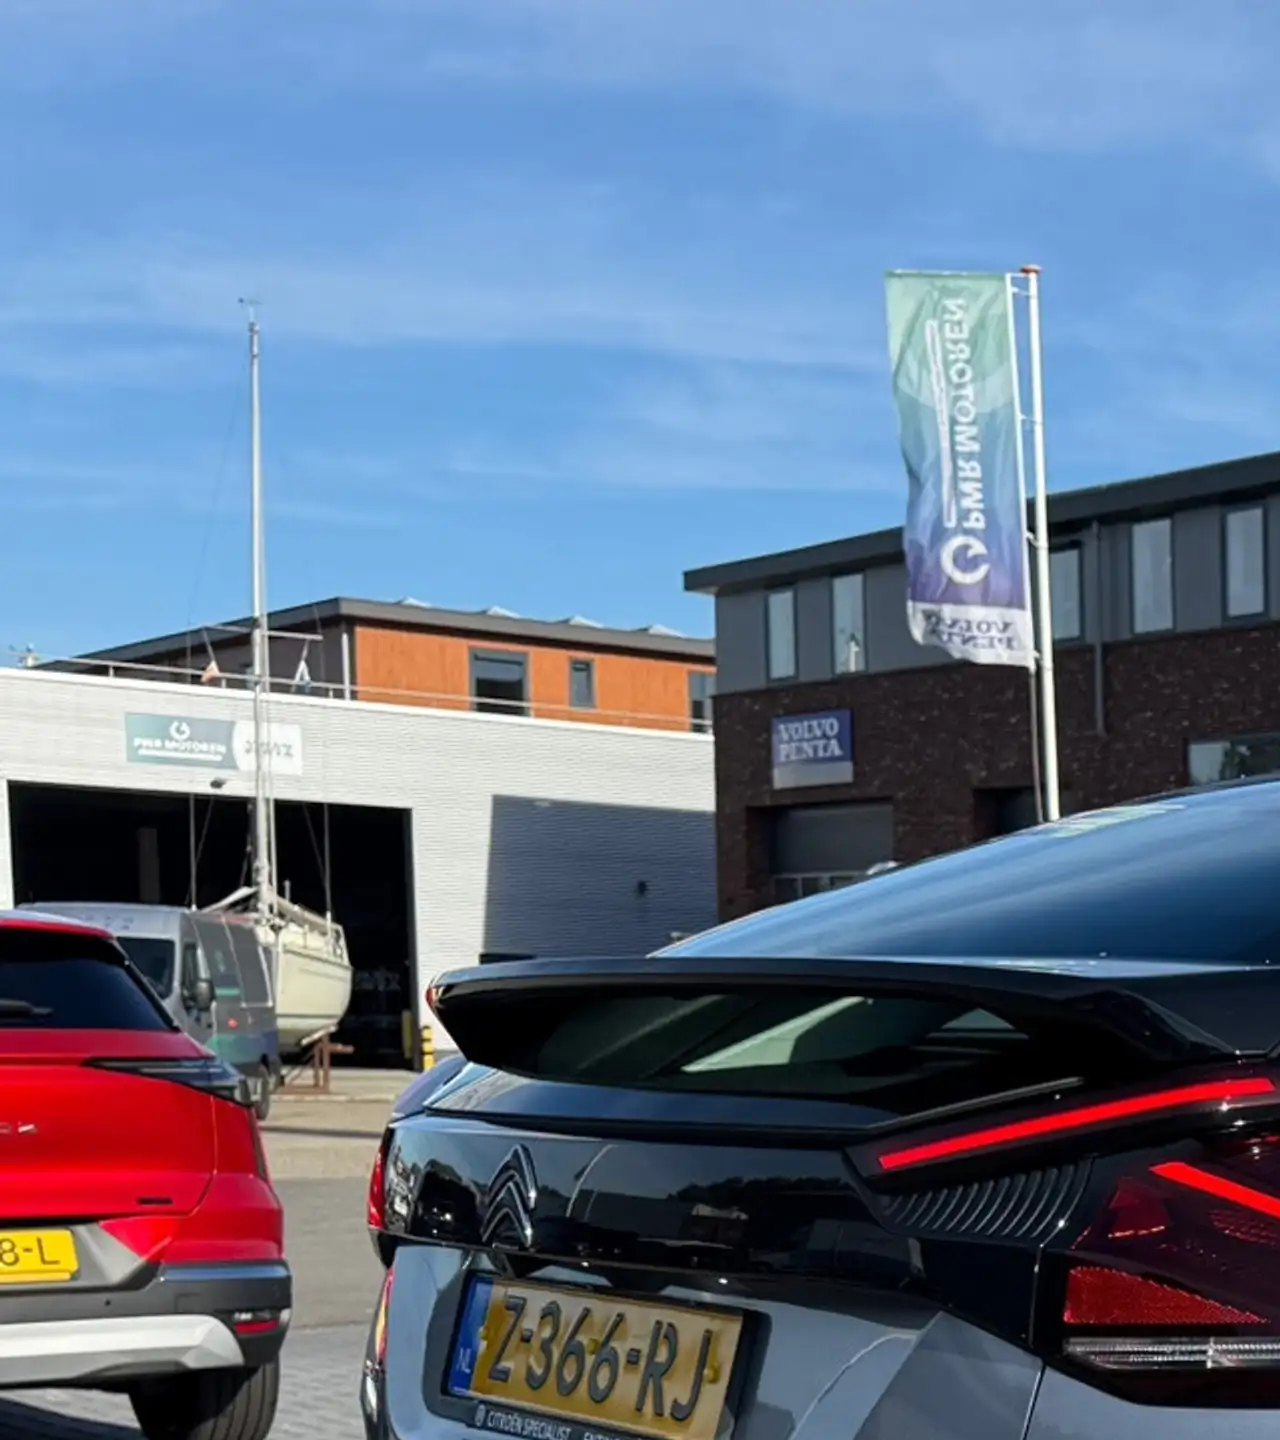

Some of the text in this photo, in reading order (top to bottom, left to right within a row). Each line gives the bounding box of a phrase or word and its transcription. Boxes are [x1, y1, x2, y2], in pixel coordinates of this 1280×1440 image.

[778, 717, 840, 741] VOLVO
[779, 739, 844, 762] PENTA
[489, 1293, 713, 1423] Z-366-RJ
